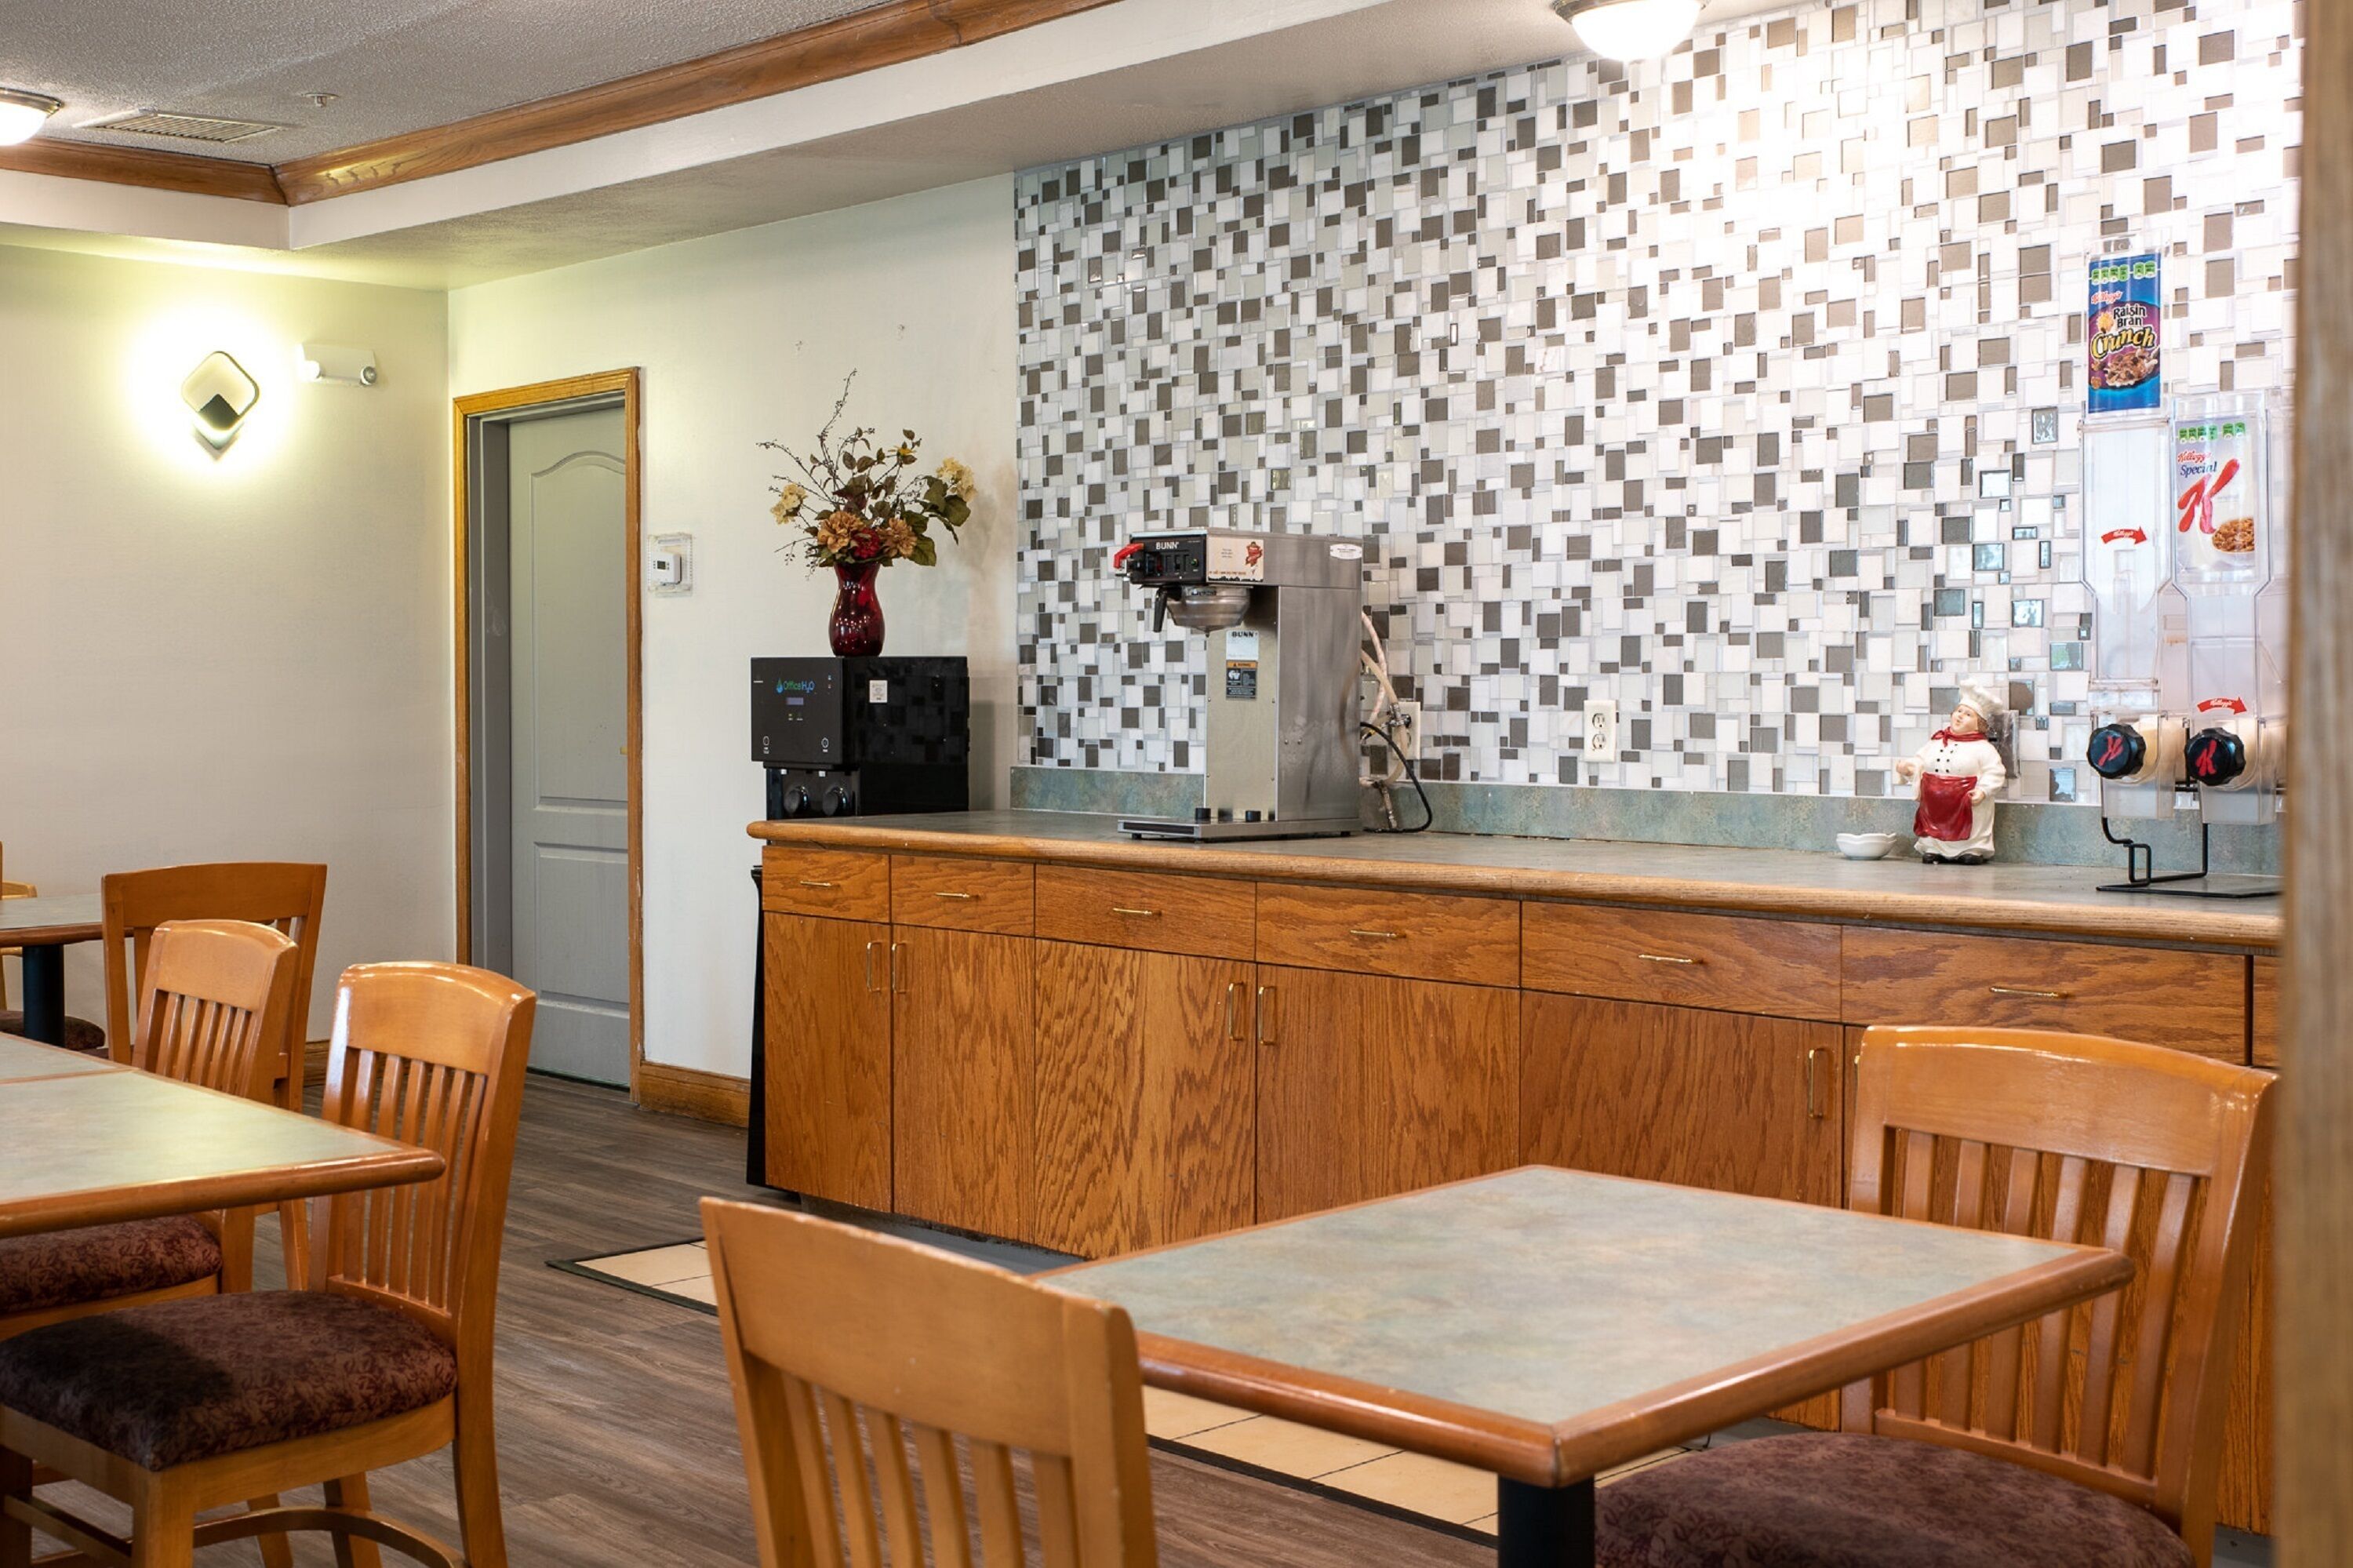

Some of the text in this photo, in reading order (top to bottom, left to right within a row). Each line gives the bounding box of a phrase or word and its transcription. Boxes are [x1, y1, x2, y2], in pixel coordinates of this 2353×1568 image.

[2113, 304, 2147, 320] Raisin
[2117, 316, 2142, 329] Bran
[2091, 326, 2156, 360] Crunch
[2180, 460, 2217, 478] Special
[2177, 457, 2240, 534] K
